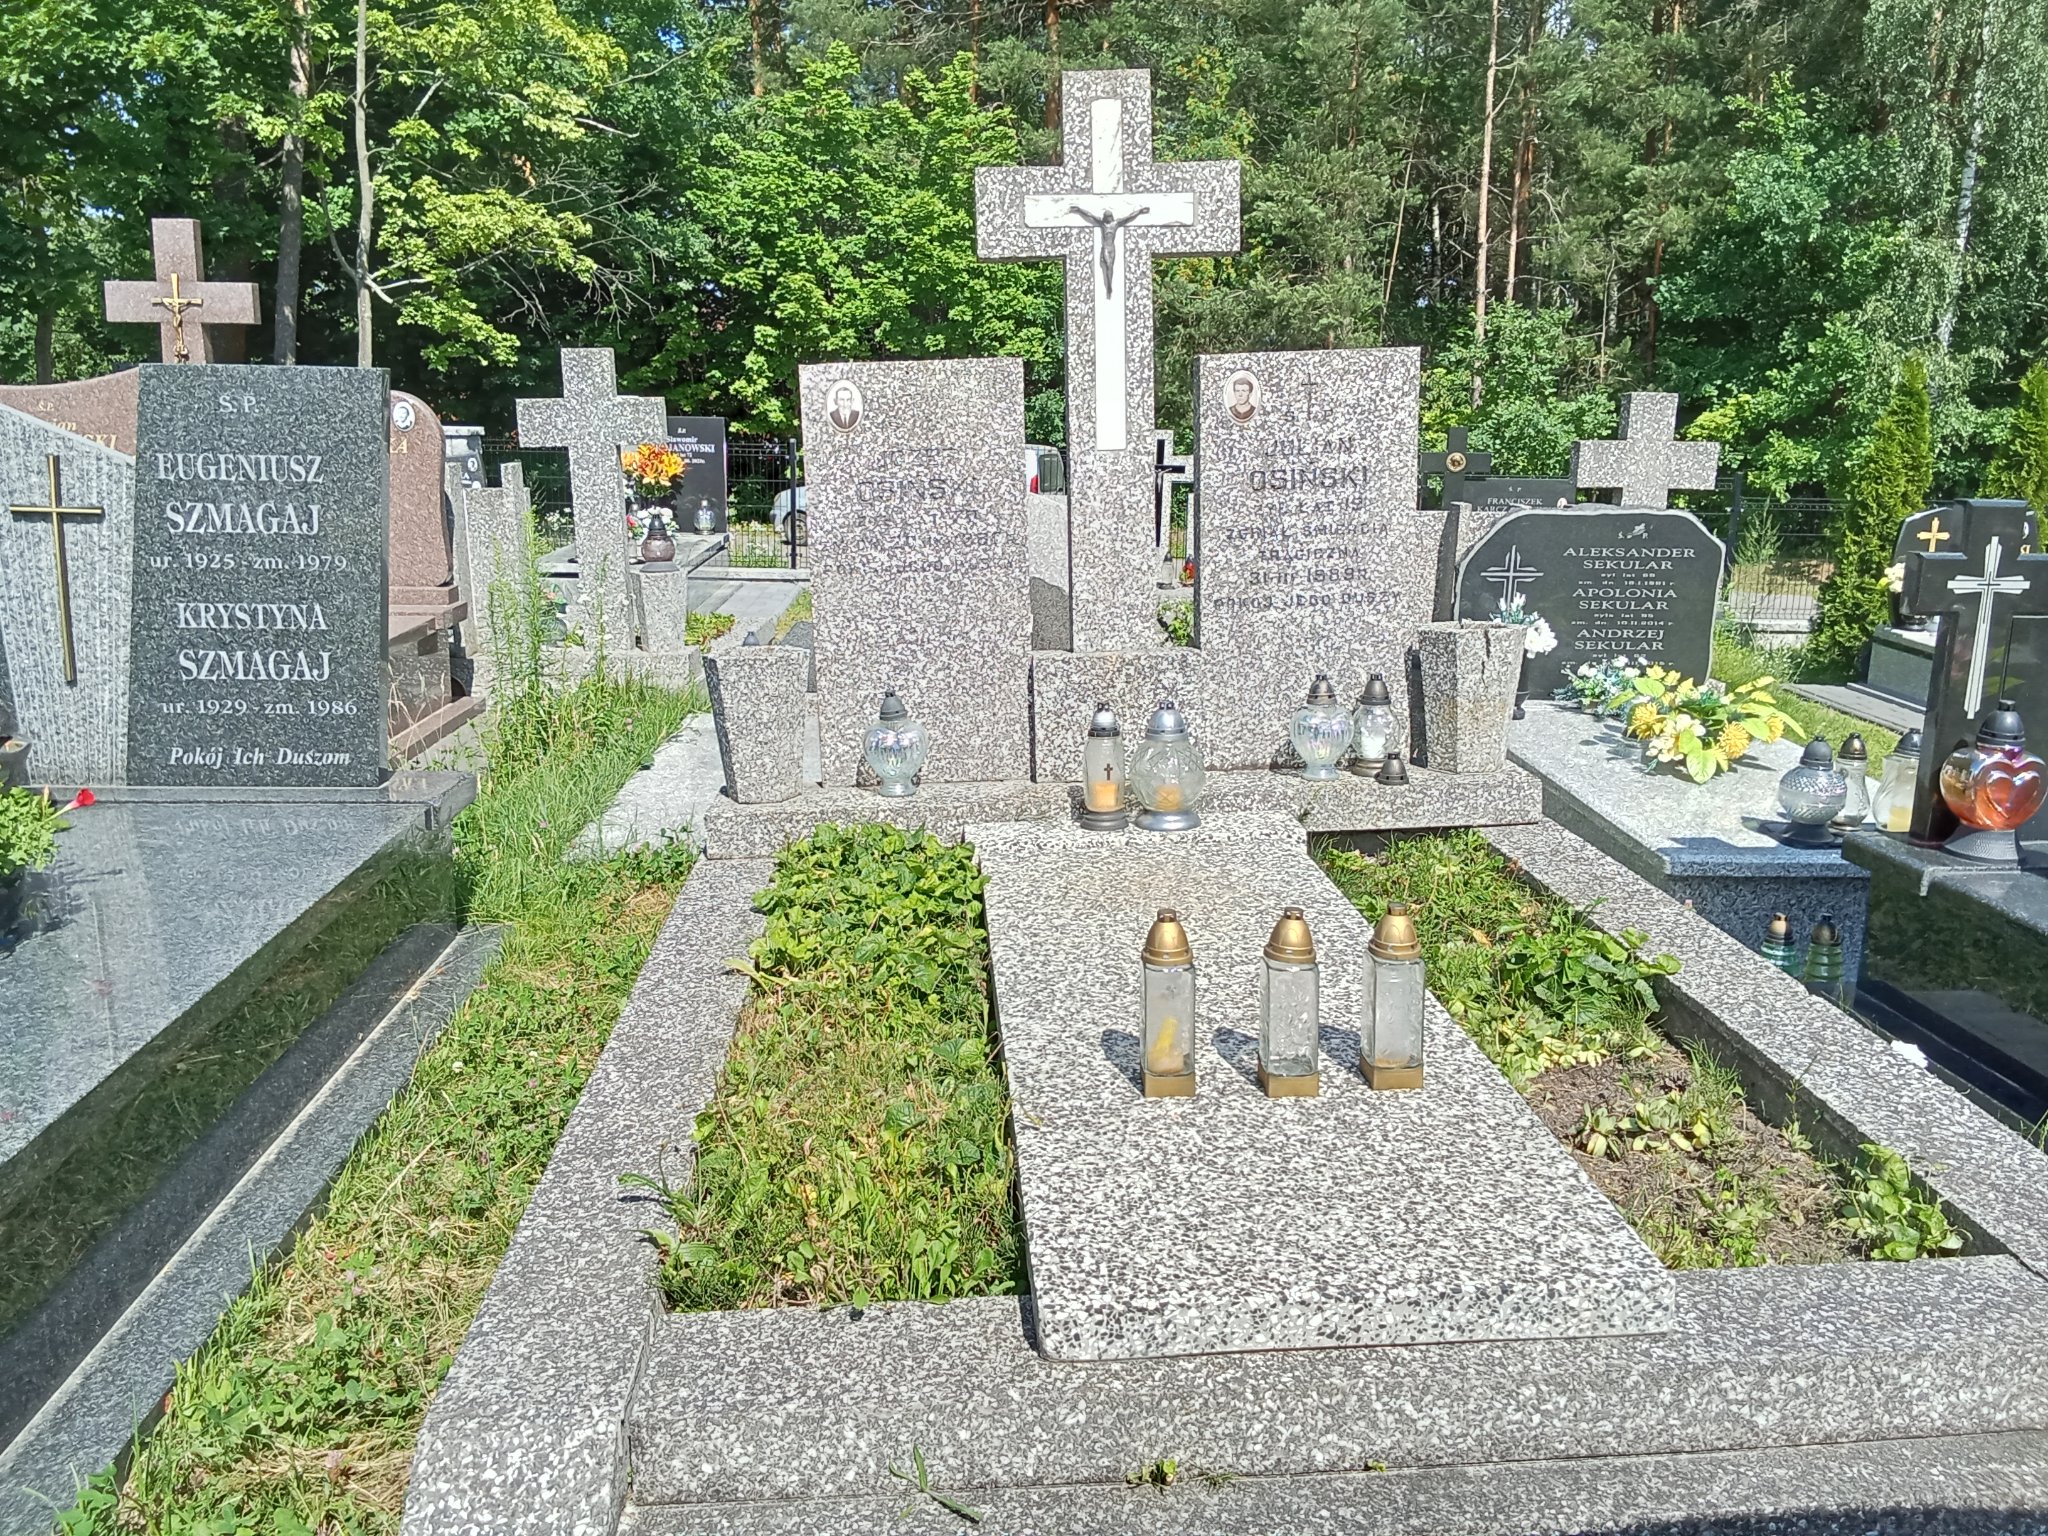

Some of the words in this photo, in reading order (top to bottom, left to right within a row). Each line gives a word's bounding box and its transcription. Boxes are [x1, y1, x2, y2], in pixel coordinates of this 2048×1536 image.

[243, 395, 260, 414] P.
[668, 443, 716, 454] JANOWSKI
[156, 453, 325, 483] EUGENIUSZ
[166, 501, 321, 535] SZMAGAJ
[1563, 547, 1696, 558] ALEKSANDER
[150, 557, 177, 569] ur.
[186, 553, 236, 570] 1925
[253, 559, 290, 571] zm.
[299, 554, 347, 572] 1979
[1583, 560, 1674, 570] SEKULAR
[1572, 588, 1678, 598] APOLONIA
[1579, 600, 1669, 610] SEKULAR
[176, 602, 328, 630] KRYSTYNA
[1577, 629, 1665, 640] ANDRZEJ
[1574, 641, 1664, 651] SEKULAR
[179, 649, 331, 682] SZMAGAJ
[161, 702, 190, 715] ur.
[199, 699, 248, 716] 1929
[264, 703, 300, 716] zm.
[308, 699, 358, 716] 1986
[169, 747, 224, 769] Pokój
[234, 748, 265, 766] Ich
[275, 748, 351, 766] Duszom
